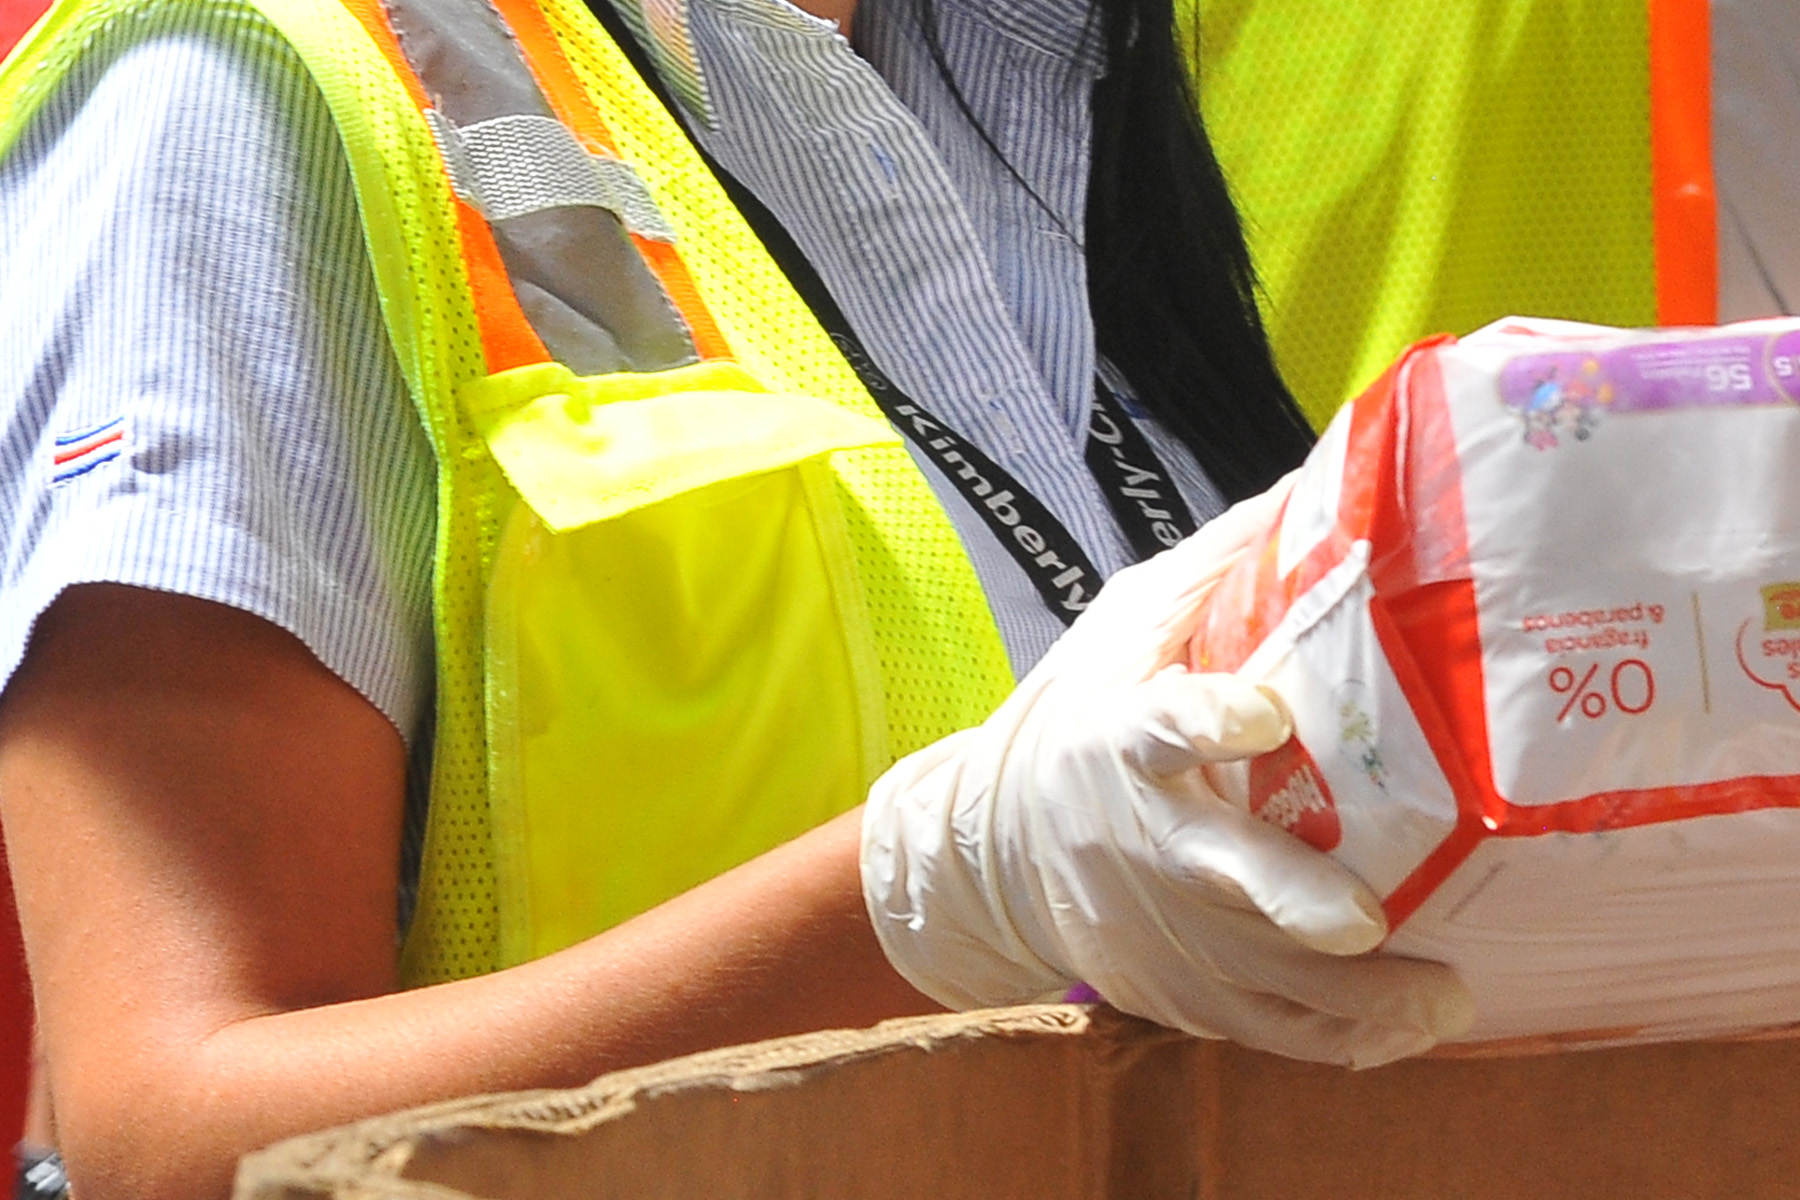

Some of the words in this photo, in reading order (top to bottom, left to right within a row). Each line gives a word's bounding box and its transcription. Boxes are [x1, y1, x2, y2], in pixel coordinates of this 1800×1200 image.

[1705, 363, 1753, 393] 56
[1086, 392, 1184, 548] erly-C
[893, 403, 1094, 611] Kimberly
[1544, 629, 1651, 658] fragancia
[1547, 658, 1656, 723] 0%
